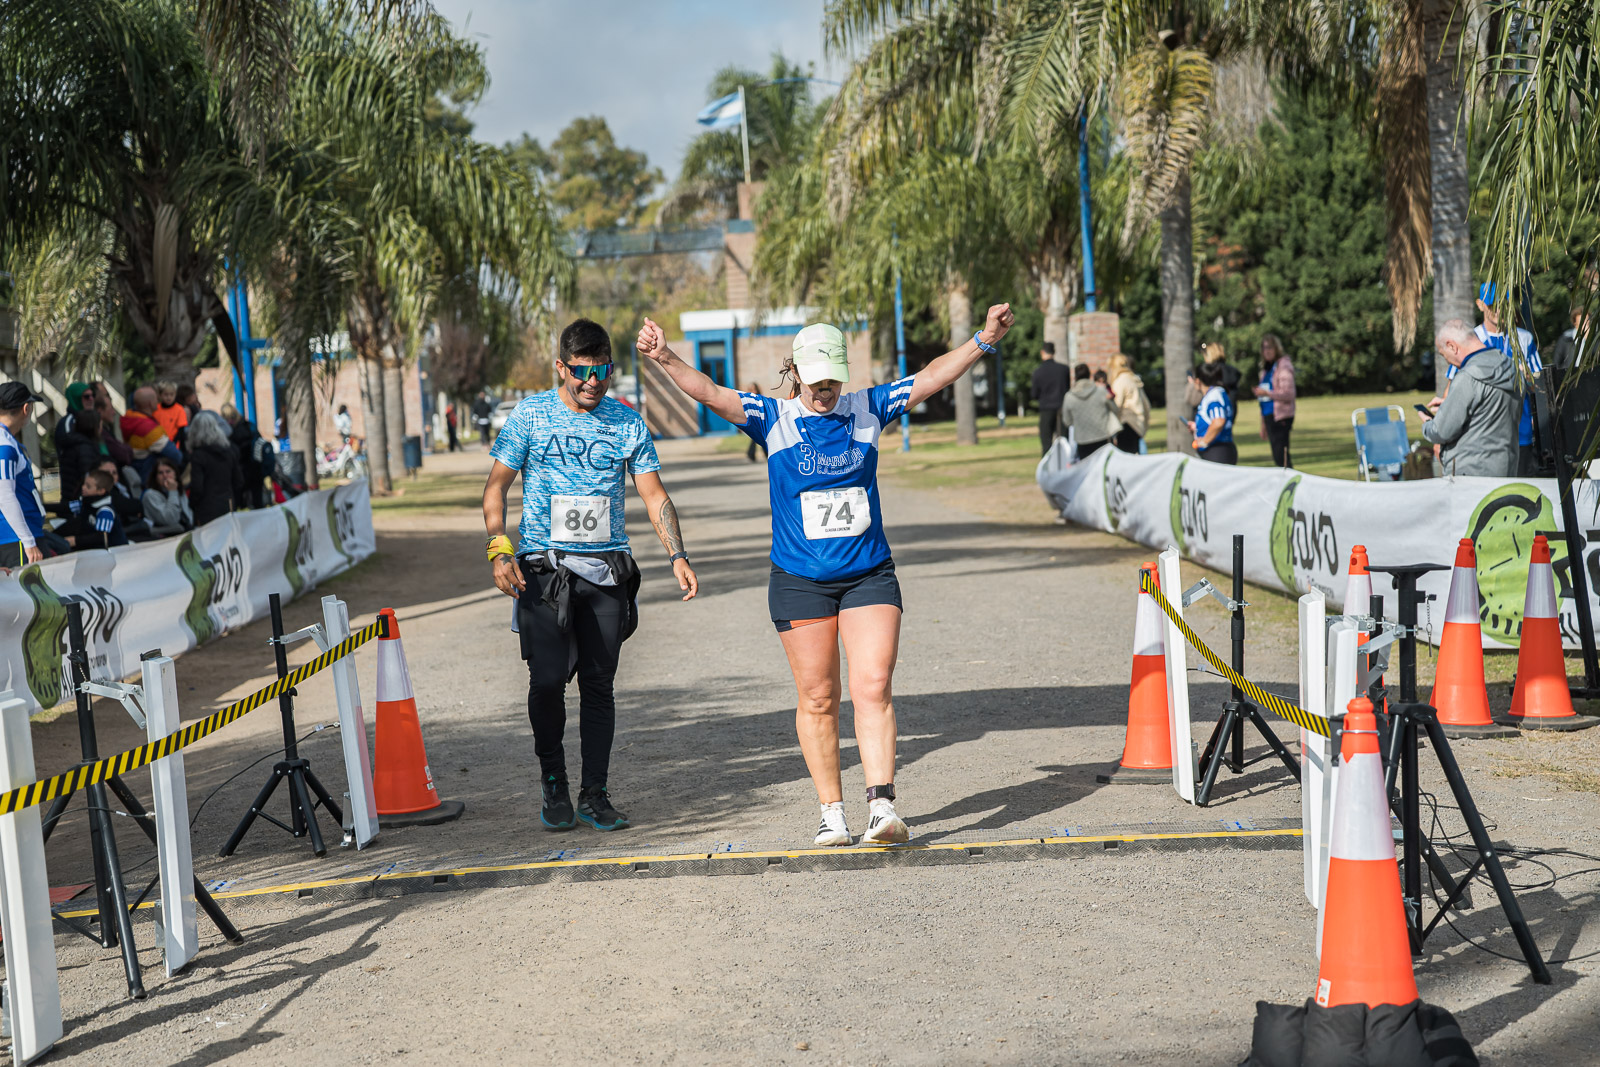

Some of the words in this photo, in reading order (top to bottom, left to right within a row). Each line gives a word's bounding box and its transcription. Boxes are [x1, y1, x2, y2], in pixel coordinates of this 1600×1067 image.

[541, 434, 615, 471] ARG
[799, 443, 816, 476] 3
[564, 508, 598, 531] 86
[817, 501, 855, 527] 74
